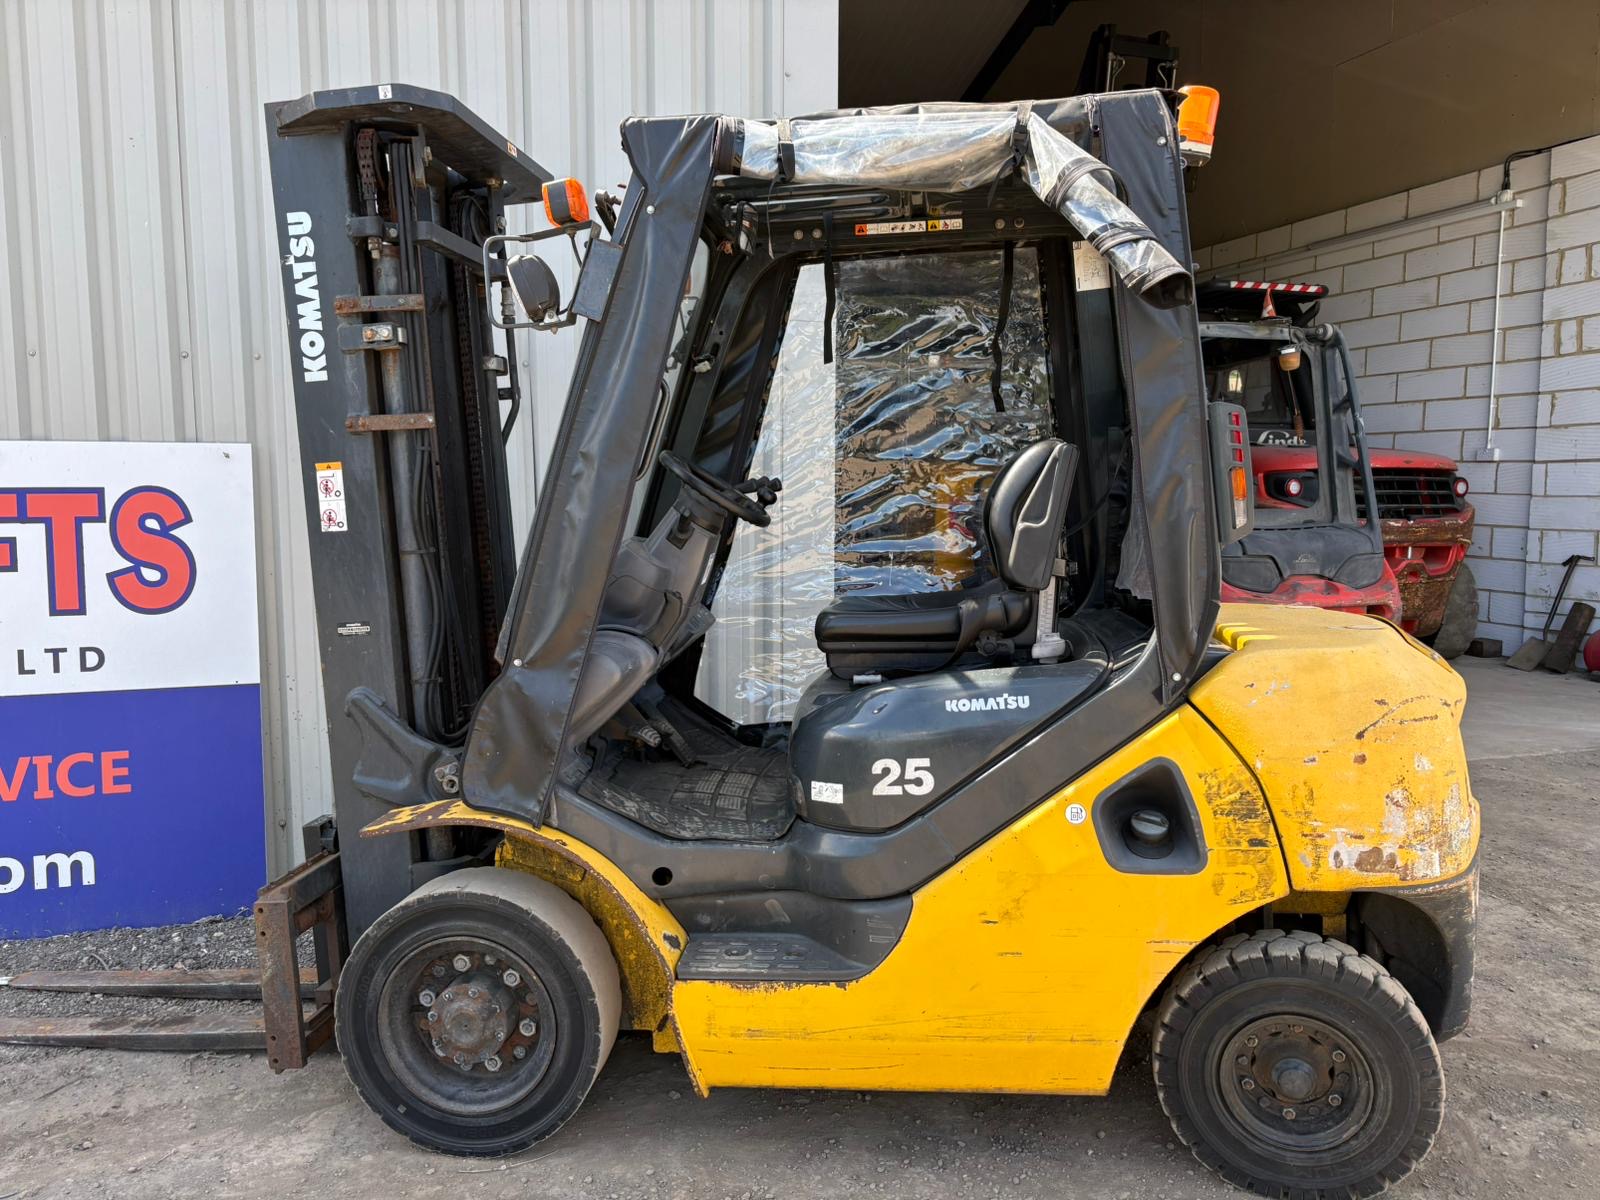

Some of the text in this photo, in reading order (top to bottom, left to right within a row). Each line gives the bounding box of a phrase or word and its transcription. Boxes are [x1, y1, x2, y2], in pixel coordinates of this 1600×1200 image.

[285, 211, 328, 383] KOMATSU
[17, 646, 106, 675] LTD
[945, 693, 1030, 713] KOMATSU
[871, 758, 935, 796] 25
